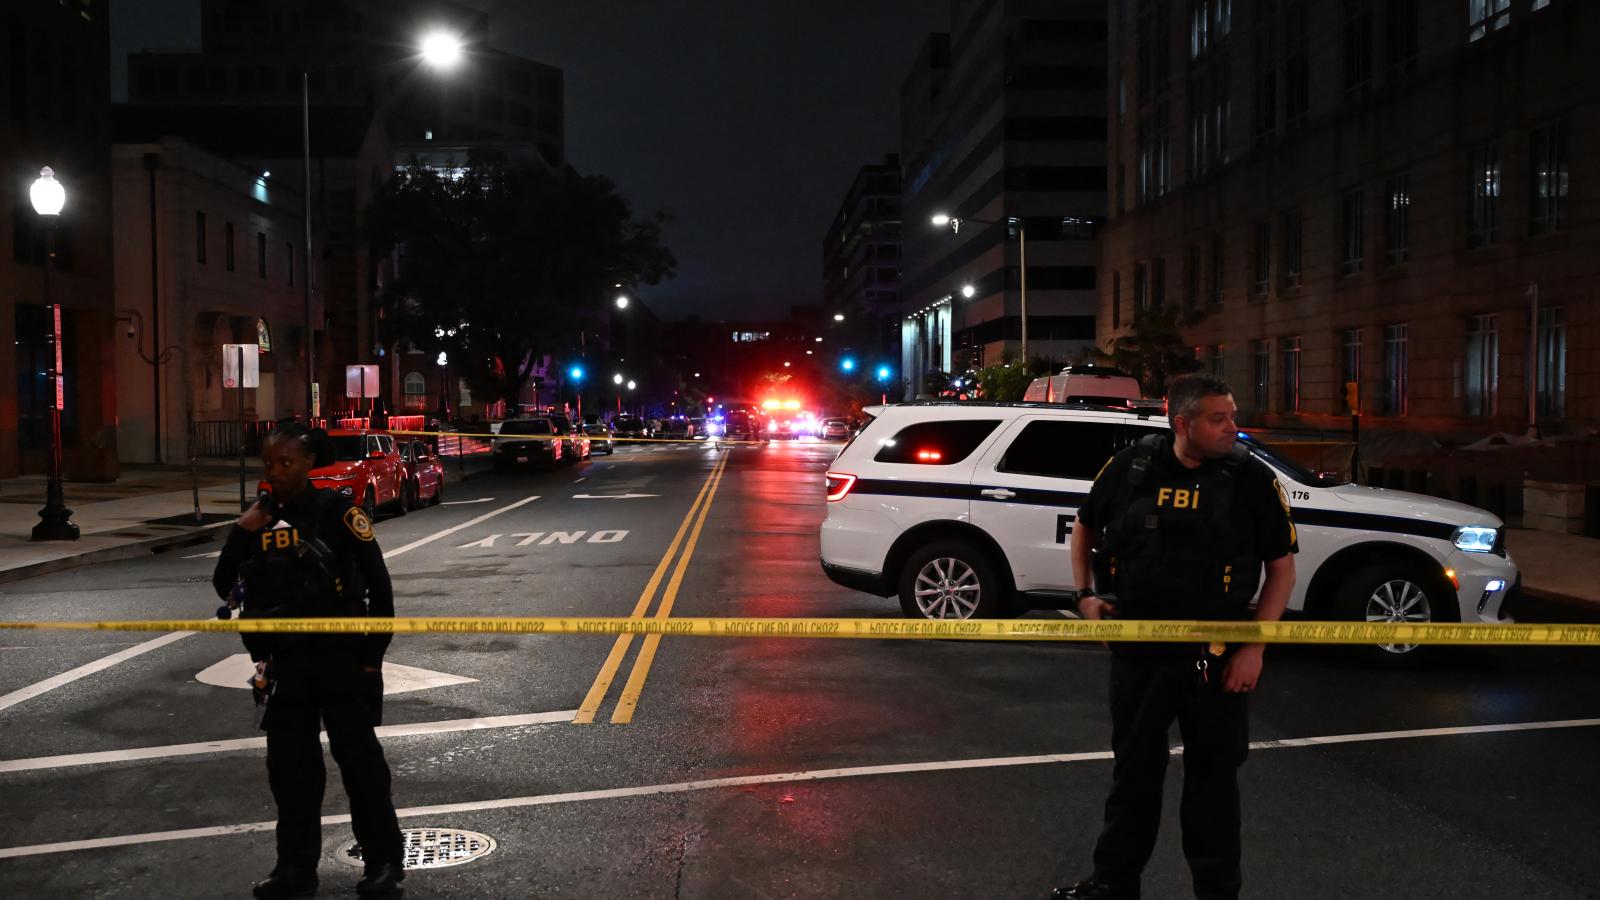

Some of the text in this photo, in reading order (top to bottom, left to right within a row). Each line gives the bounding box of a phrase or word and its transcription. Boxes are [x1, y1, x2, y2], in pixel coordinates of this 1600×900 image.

[1157, 487, 1200, 510] FBI
[1291, 490, 1310, 501] 176
[261, 527, 301, 552] FBI
[456, 530, 630, 549] ONLY
[1223, 565, 1232, 593] FBI
